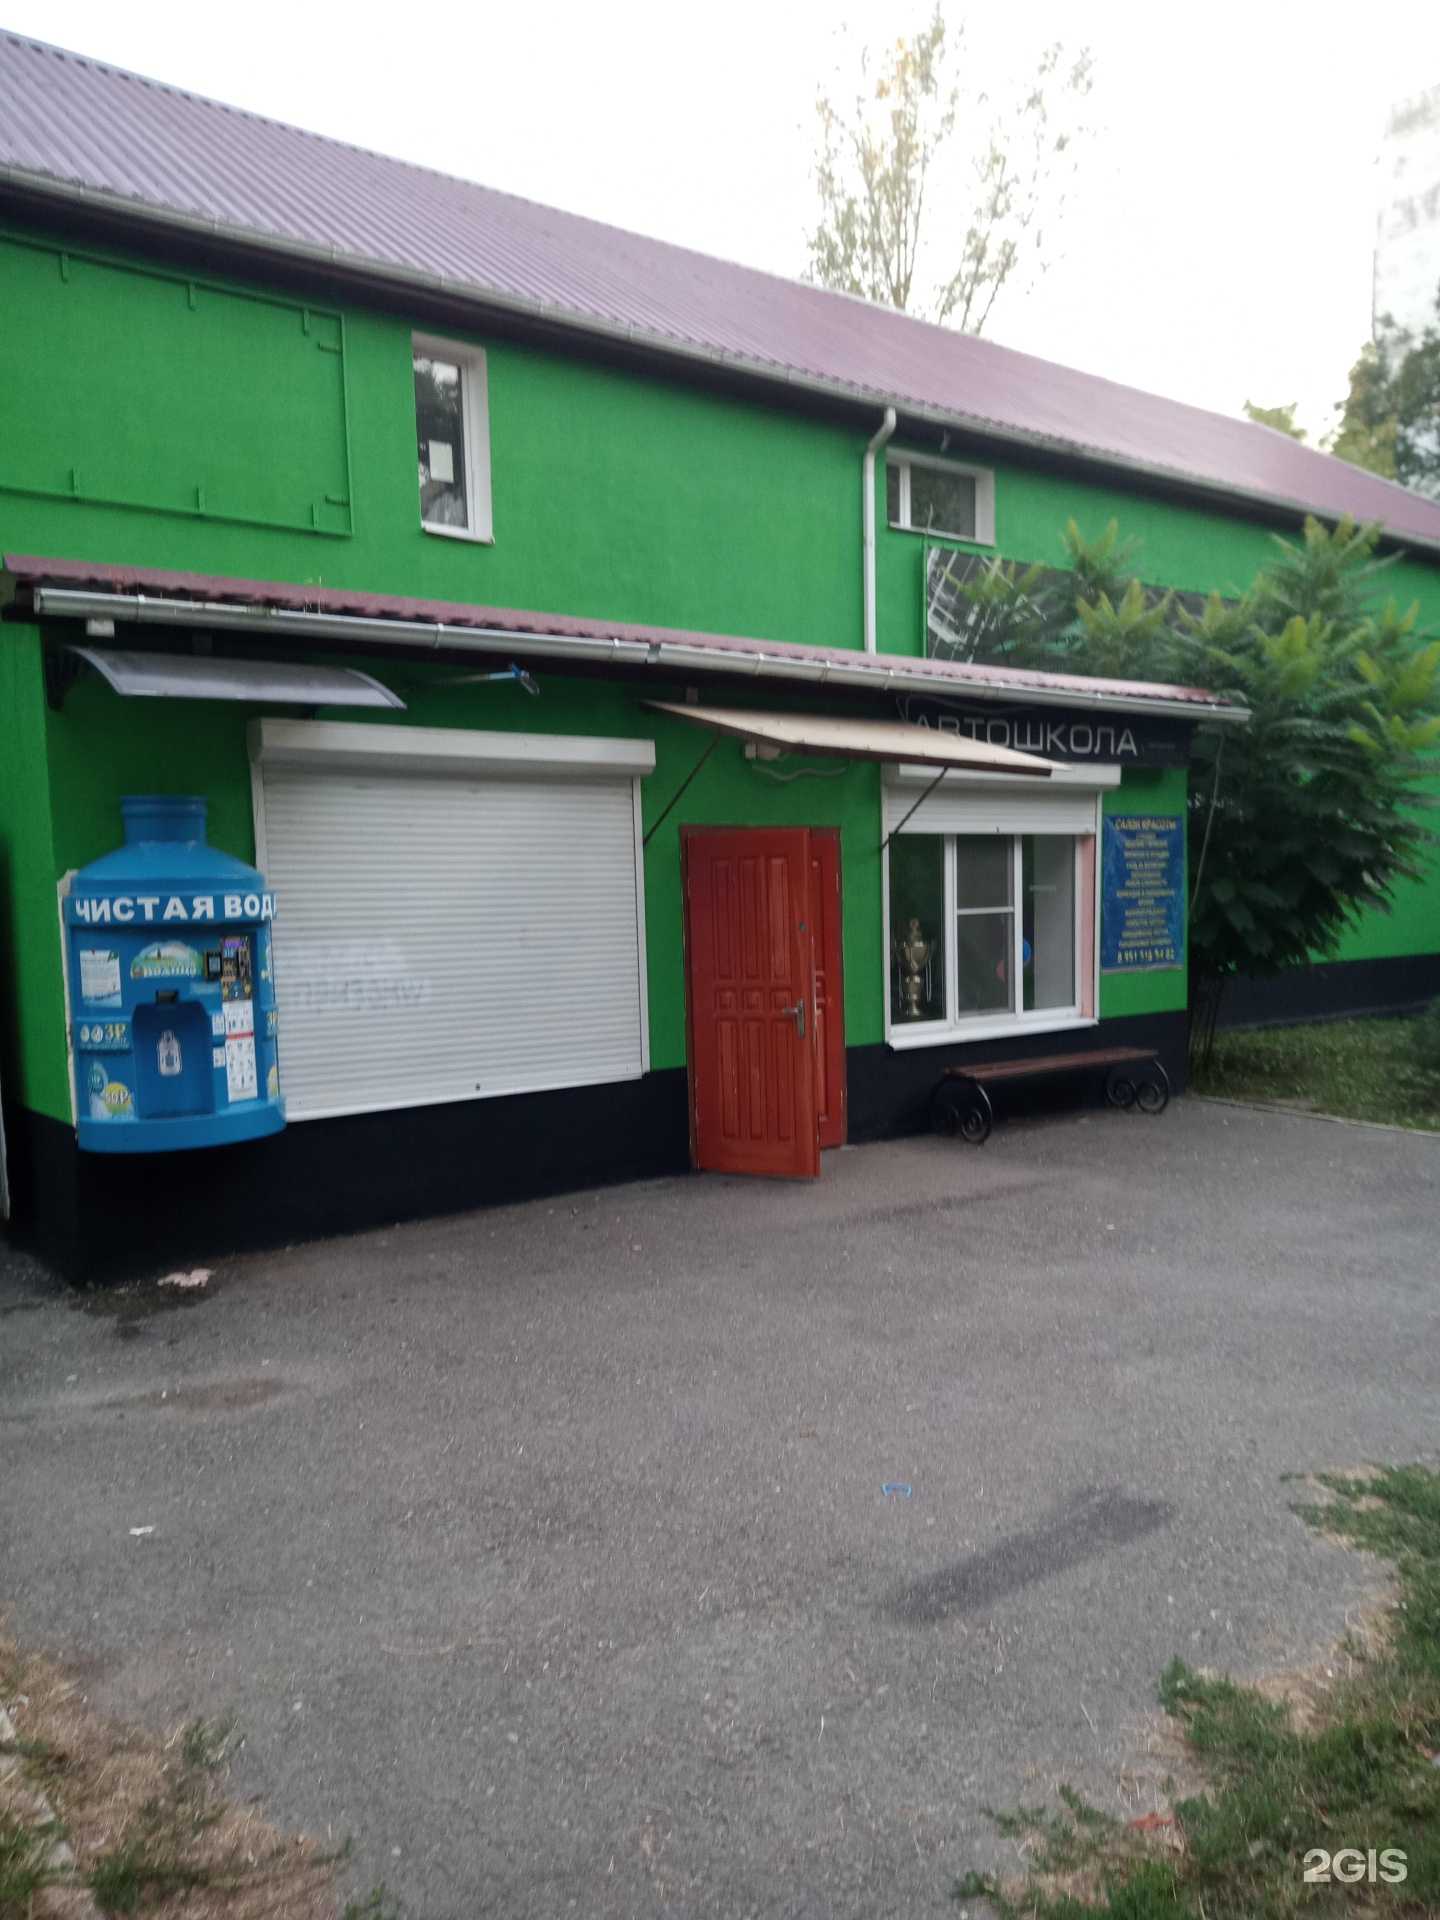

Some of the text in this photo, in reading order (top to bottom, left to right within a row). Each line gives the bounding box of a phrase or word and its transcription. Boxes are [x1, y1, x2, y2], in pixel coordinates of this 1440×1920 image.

[912, 713, 1138, 757] АВТОШКОЛА
[75, 893, 276, 922] ЧИСТАЯ ВОД
